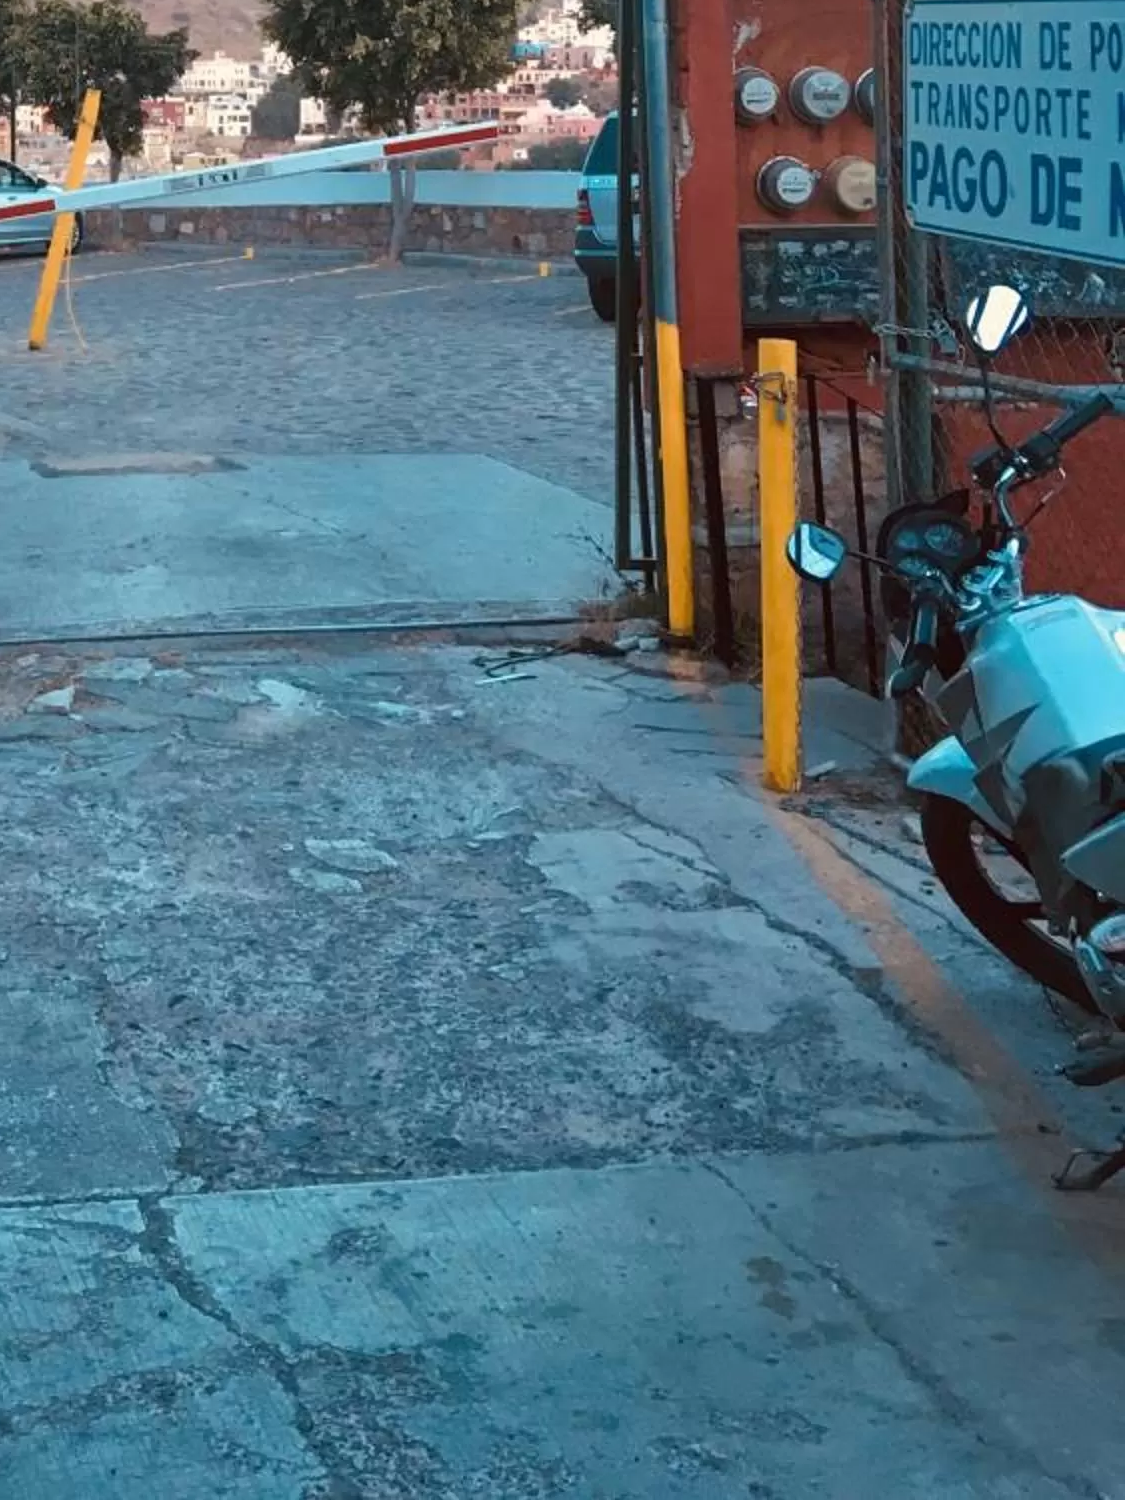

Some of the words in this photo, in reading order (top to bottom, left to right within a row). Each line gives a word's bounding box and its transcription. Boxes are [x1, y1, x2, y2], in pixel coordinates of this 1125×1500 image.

[909, 21, 1022, 69] DIRECCION
[1039, 21, 1072, 71] DE
[910, 80, 1092, 141] TRANSPORTE
[909, 140, 1008, 219] PAGO
[1030, 153, 1083, 232] DE
